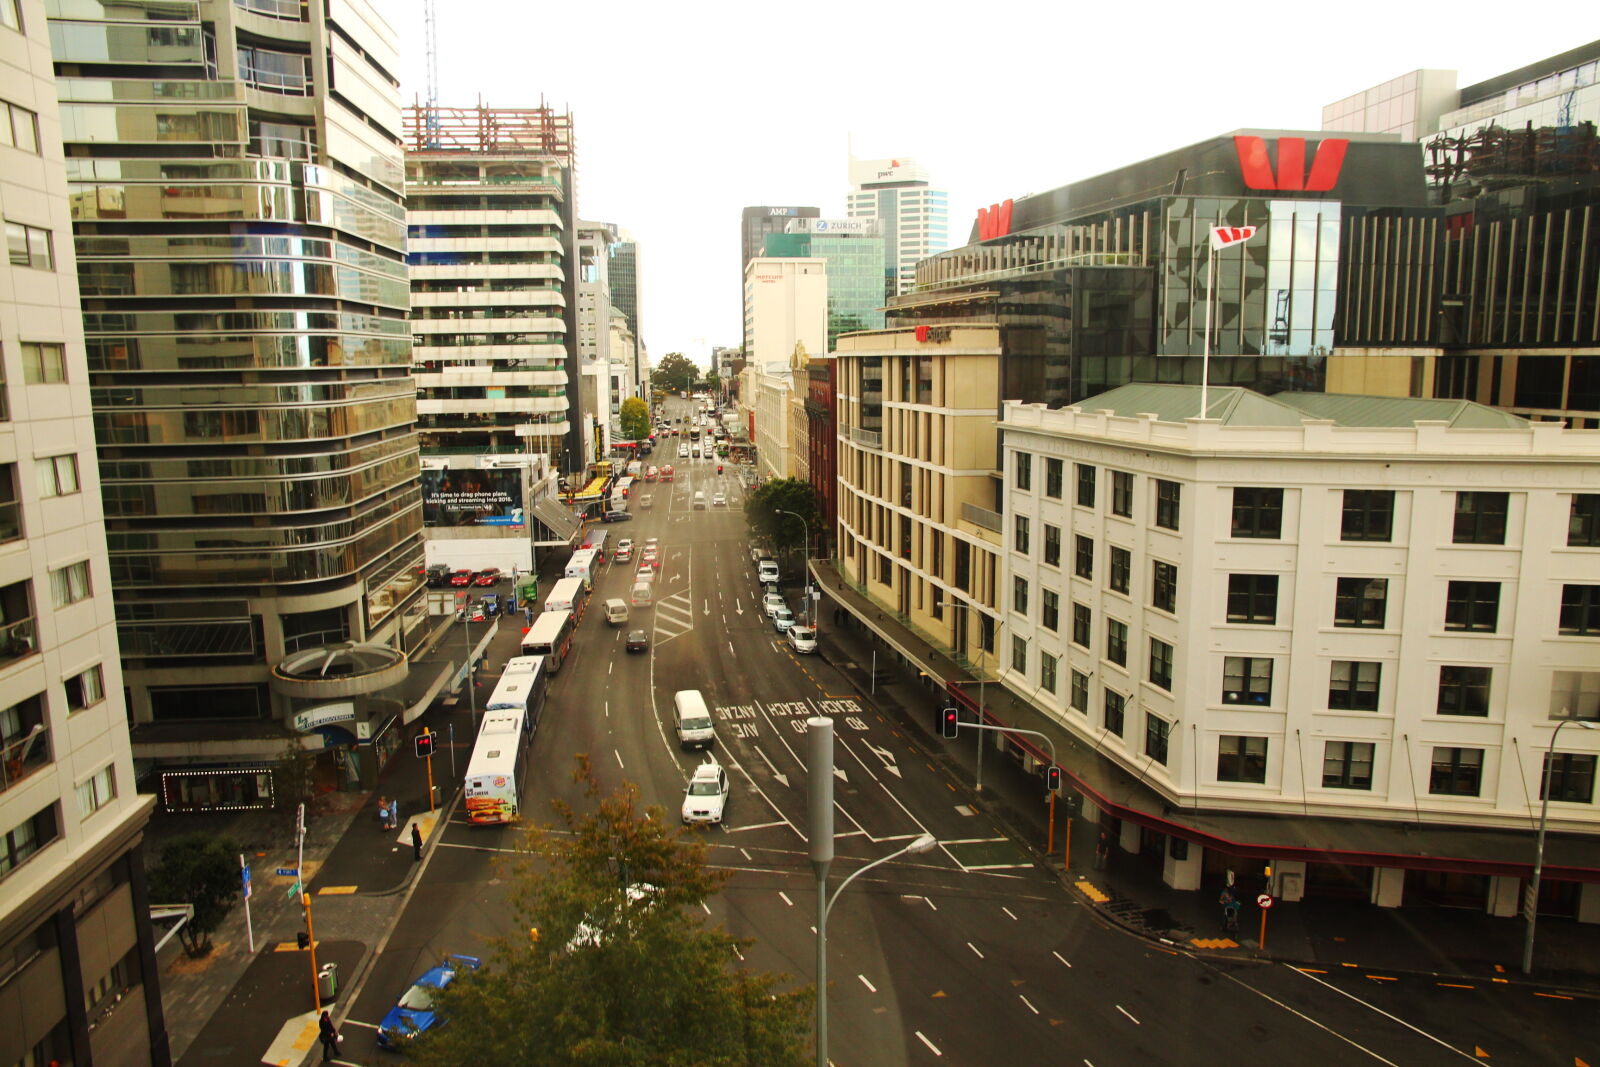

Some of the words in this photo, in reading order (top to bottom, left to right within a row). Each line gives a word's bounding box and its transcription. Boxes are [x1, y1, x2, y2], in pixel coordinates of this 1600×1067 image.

[878, 170, 894, 179] pwc
[769, 207, 788, 216] AMP
[831, 222, 862, 230] ZURICH
[461, 491, 473, 499] drag
[715, 705, 757, 720] ANZAC
[766, 701, 810, 716] BEACH
[818, 700, 863, 714] BEACH
[732, 722, 759, 738] AVE
[845, 716, 870, 731] RD
